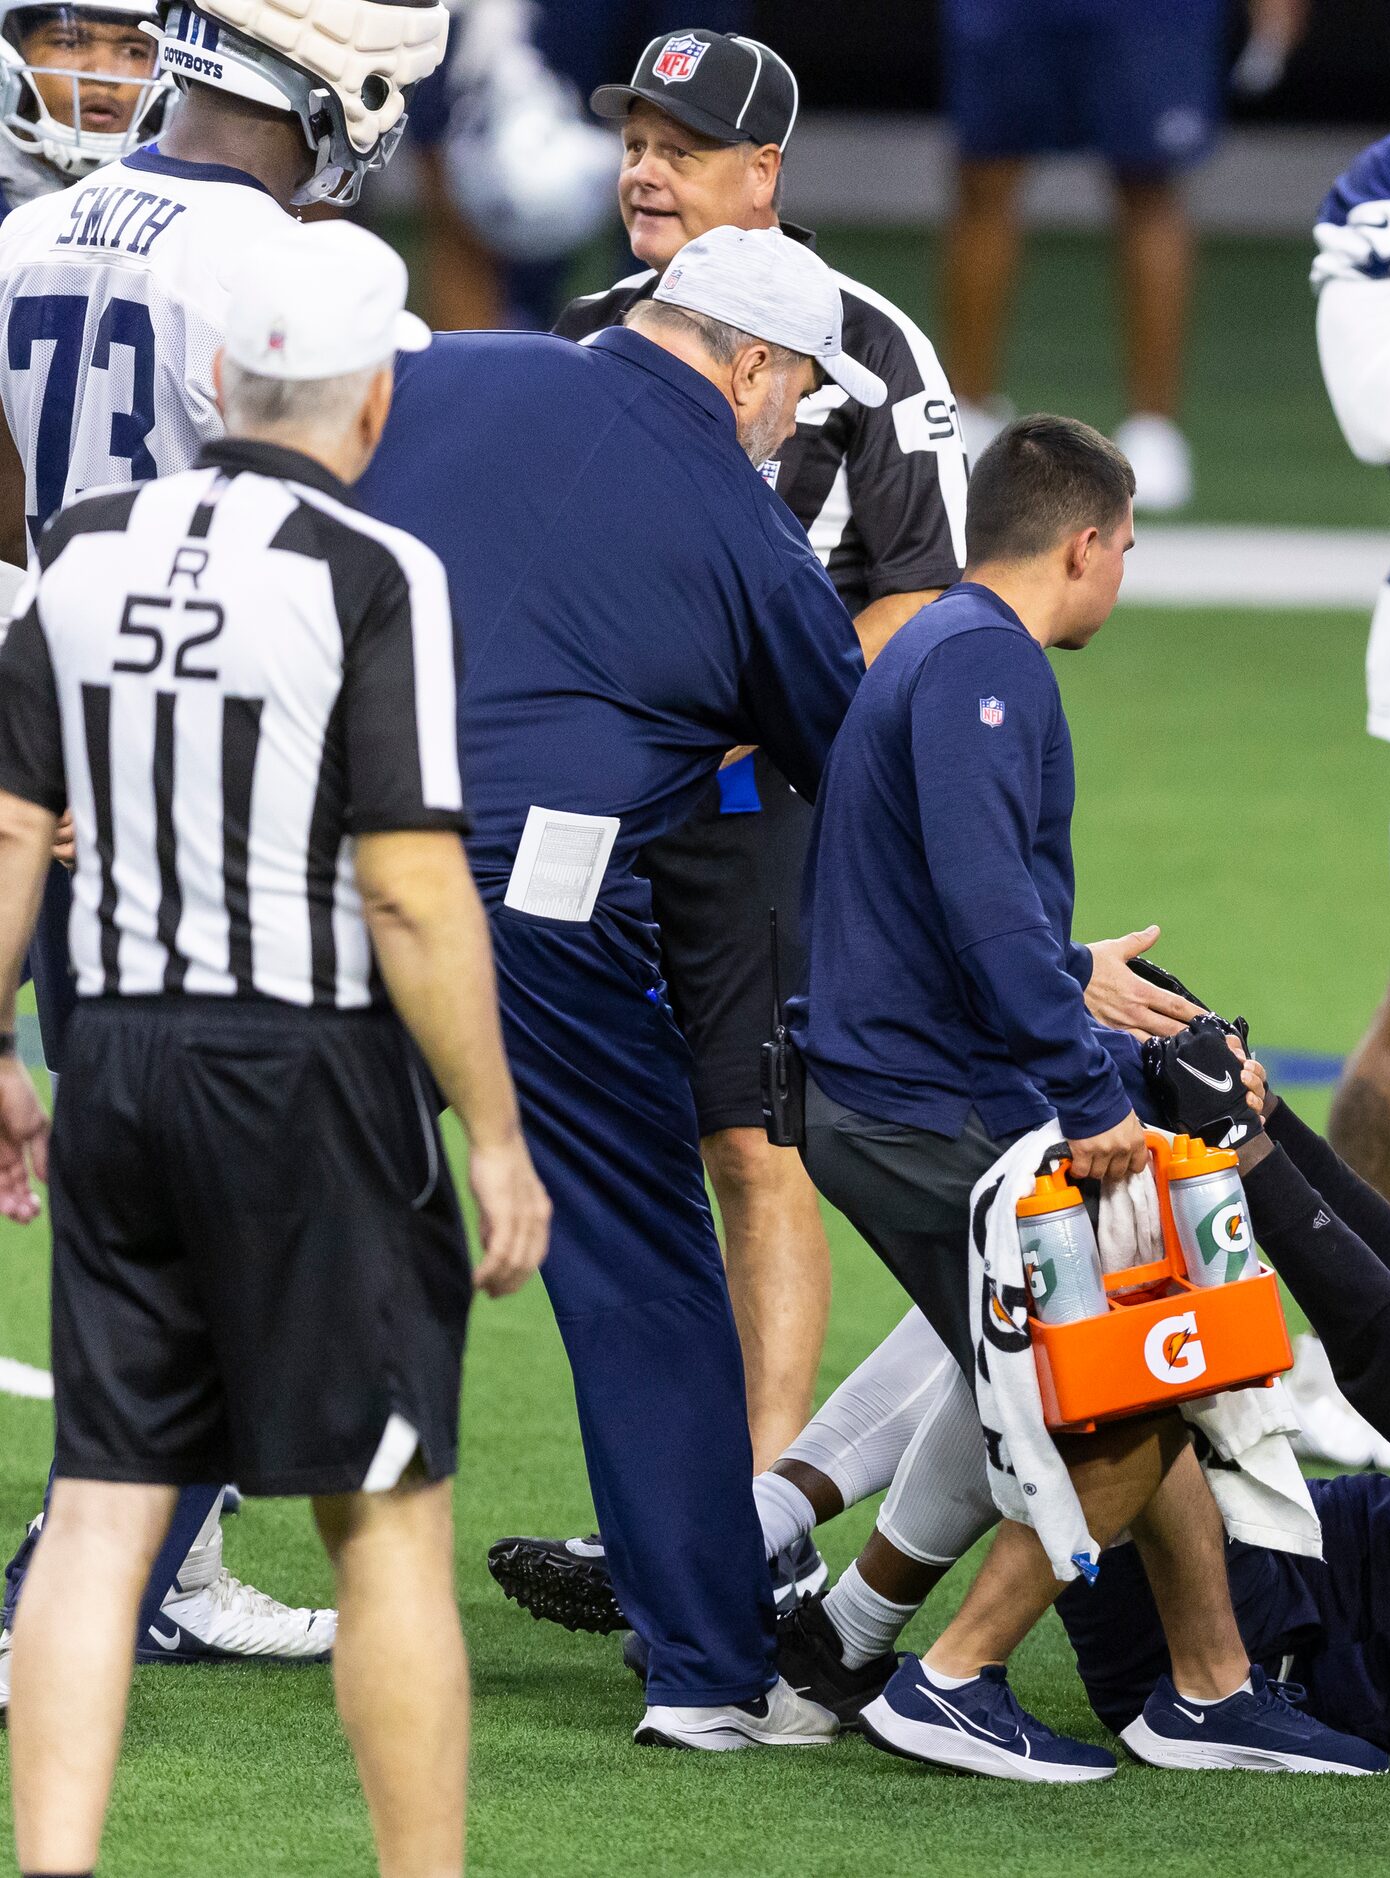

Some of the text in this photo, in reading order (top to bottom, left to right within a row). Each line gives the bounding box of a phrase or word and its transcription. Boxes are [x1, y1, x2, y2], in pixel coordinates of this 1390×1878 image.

[164, 46, 223, 79] COWBOYS
[656, 53, 691, 77] NFL
[56, 187, 187, 257] SMITH
[8, 295, 157, 525] 73
[167, 547, 209, 590] R
[113, 595, 224, 680] 52
[984, 708, 1002, 723] NFL
[1212, 1202, 1251, 1253] G
[1144, 1310, 1207, 1384] G
